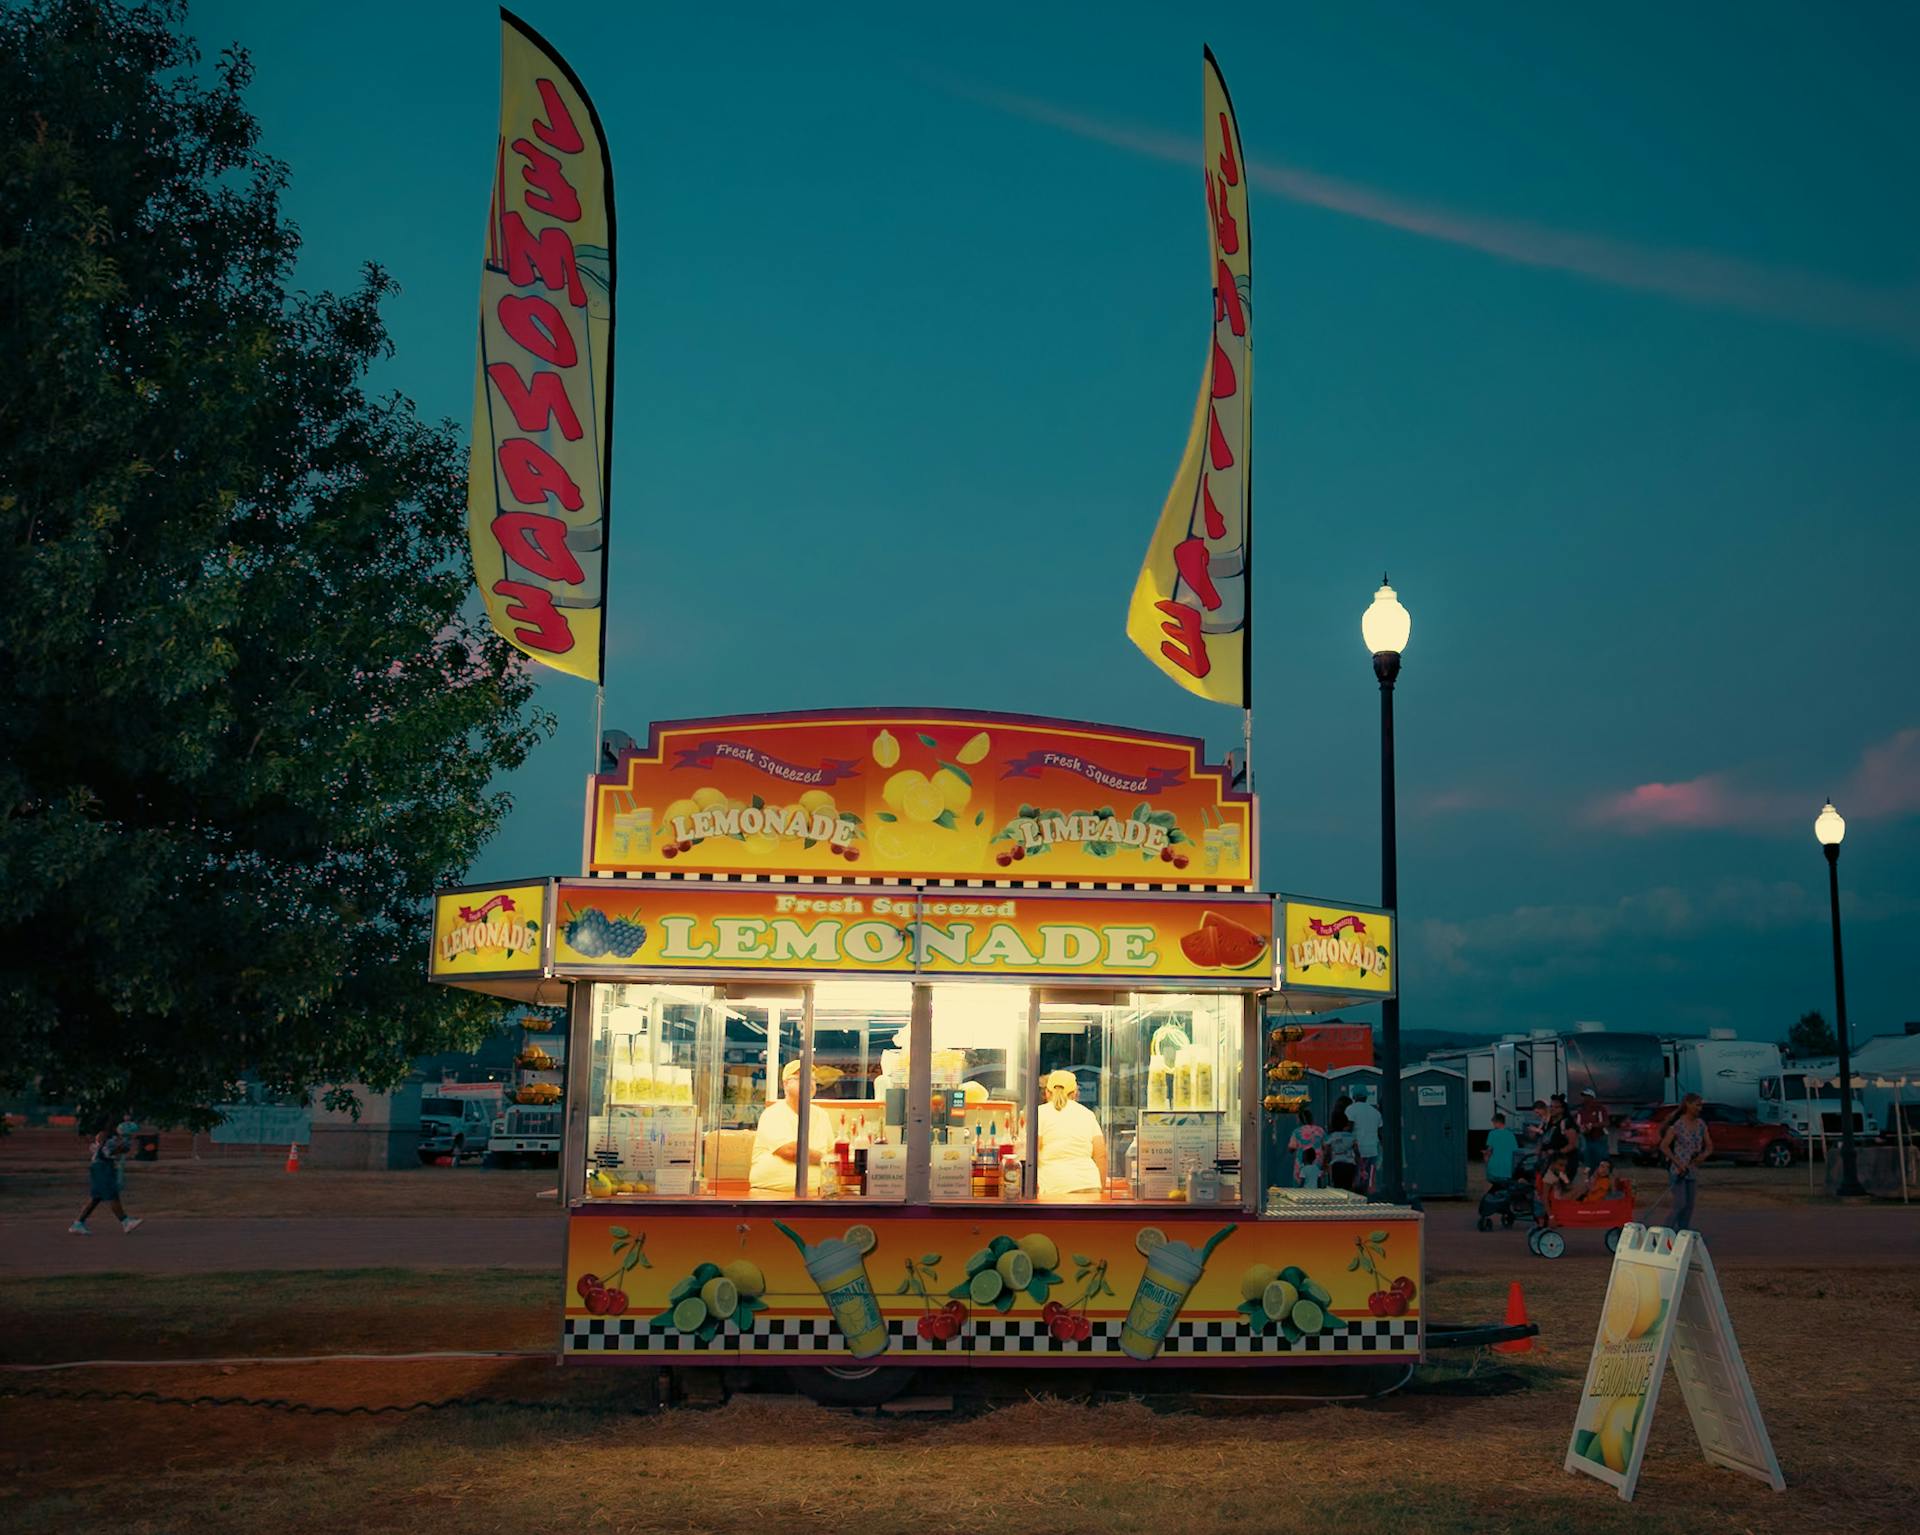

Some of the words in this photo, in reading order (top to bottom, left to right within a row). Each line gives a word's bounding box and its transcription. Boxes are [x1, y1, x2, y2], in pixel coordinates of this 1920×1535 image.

[716, 744, 755, 763] Fresh
[758, 754, 822, 784] Squeezed
[1044, 753, 1082, 772] Fresh
[1085, 764, 1148, 792] Squeezed
[672, 806, 856, 848] LEMONADE
[1020, 814, 1169, 851] LIMEADE
[776, 894, 863, 914] Fresh
[441, 921, 537, 961] LEMONADE
[659, 916, 1158, 967] LEMONADE
[1292, 938, 1387, 977] LEMONADE
